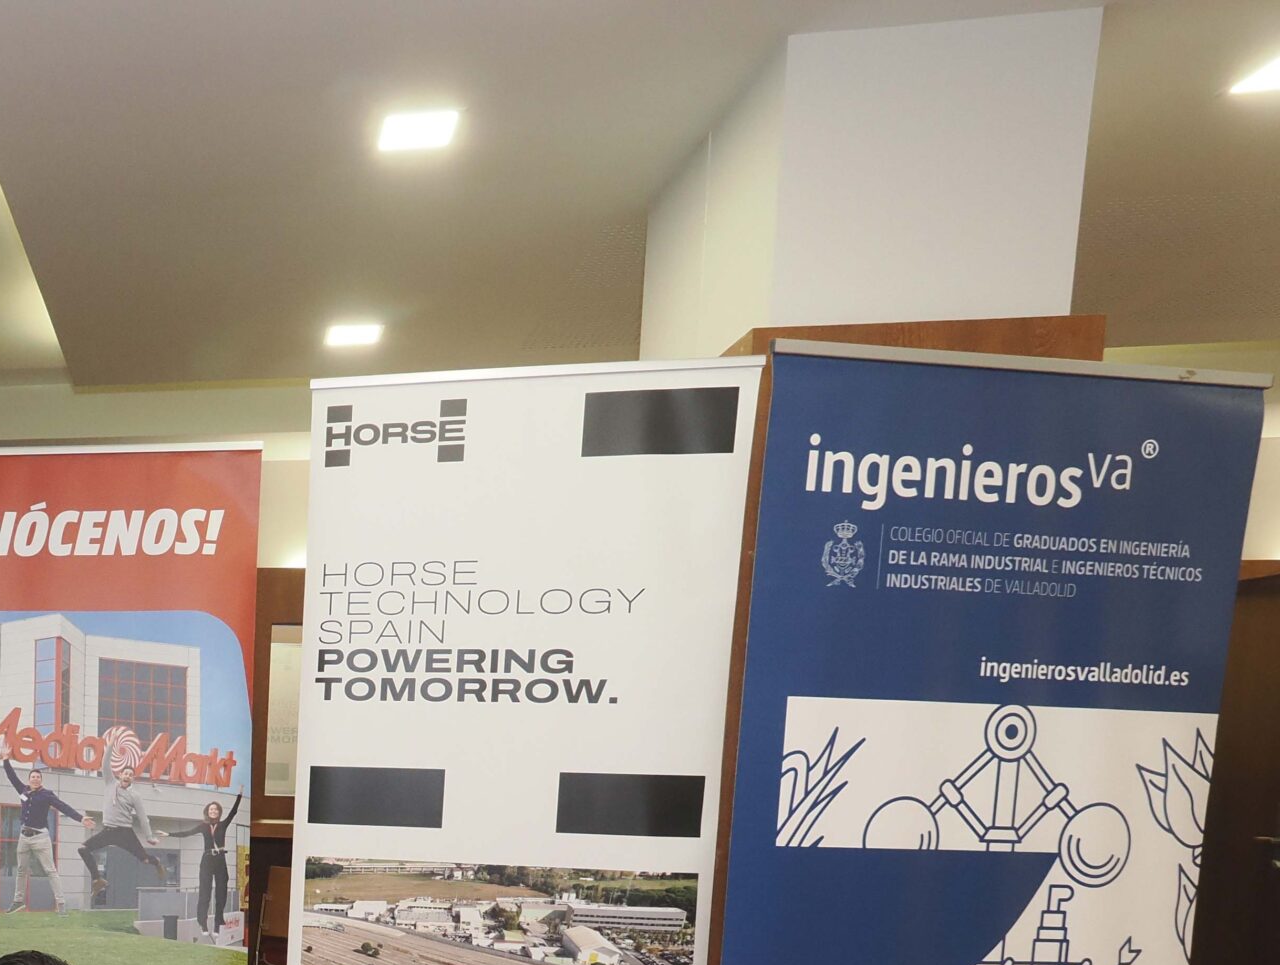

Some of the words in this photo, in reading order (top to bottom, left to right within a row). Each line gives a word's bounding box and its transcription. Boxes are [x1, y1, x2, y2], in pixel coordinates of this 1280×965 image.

[890, 526, 944, 543] COLEGIO
[946, 529, 990, 547] OFICIAL
[993, 532, 1010, 547] DE
[1013, 534, 1097, 553] GRADUADOS
[1099, 538, 1118, 554] EN
[1119, 540, 1191, 558] INGENIERÍA
[323, 560, 478, 587] HORSE
[888, 549, 907, 565] DE
[910, 551, 927, 566] LA
[930, 552, 968, 568] RAMA
[970, 554, 1049, 573] INDUSTRIAL
[1051, 559, 1059, 574] E
[1061, 560, 1139, 578] INGENIEROS
[1142, 561, 1202, 582] TÉCNICOS
[886, 573, 981, 592] INDUSTRIALES
[984, 578, 1002, 593] DE
[1005, 579, 1076, 598] VALLADOLID
[320, 588, 646, 616] TECHNOLOGY
[318, 619, 445, 645] SPAIN
[317, 649, 574, 674] POWERING
[979, 656, 1190, 686] ingenierosvalladolid.es
[315, 677, 618, 704] TOMORROW.
[135, 732, 237, 788] Markt
